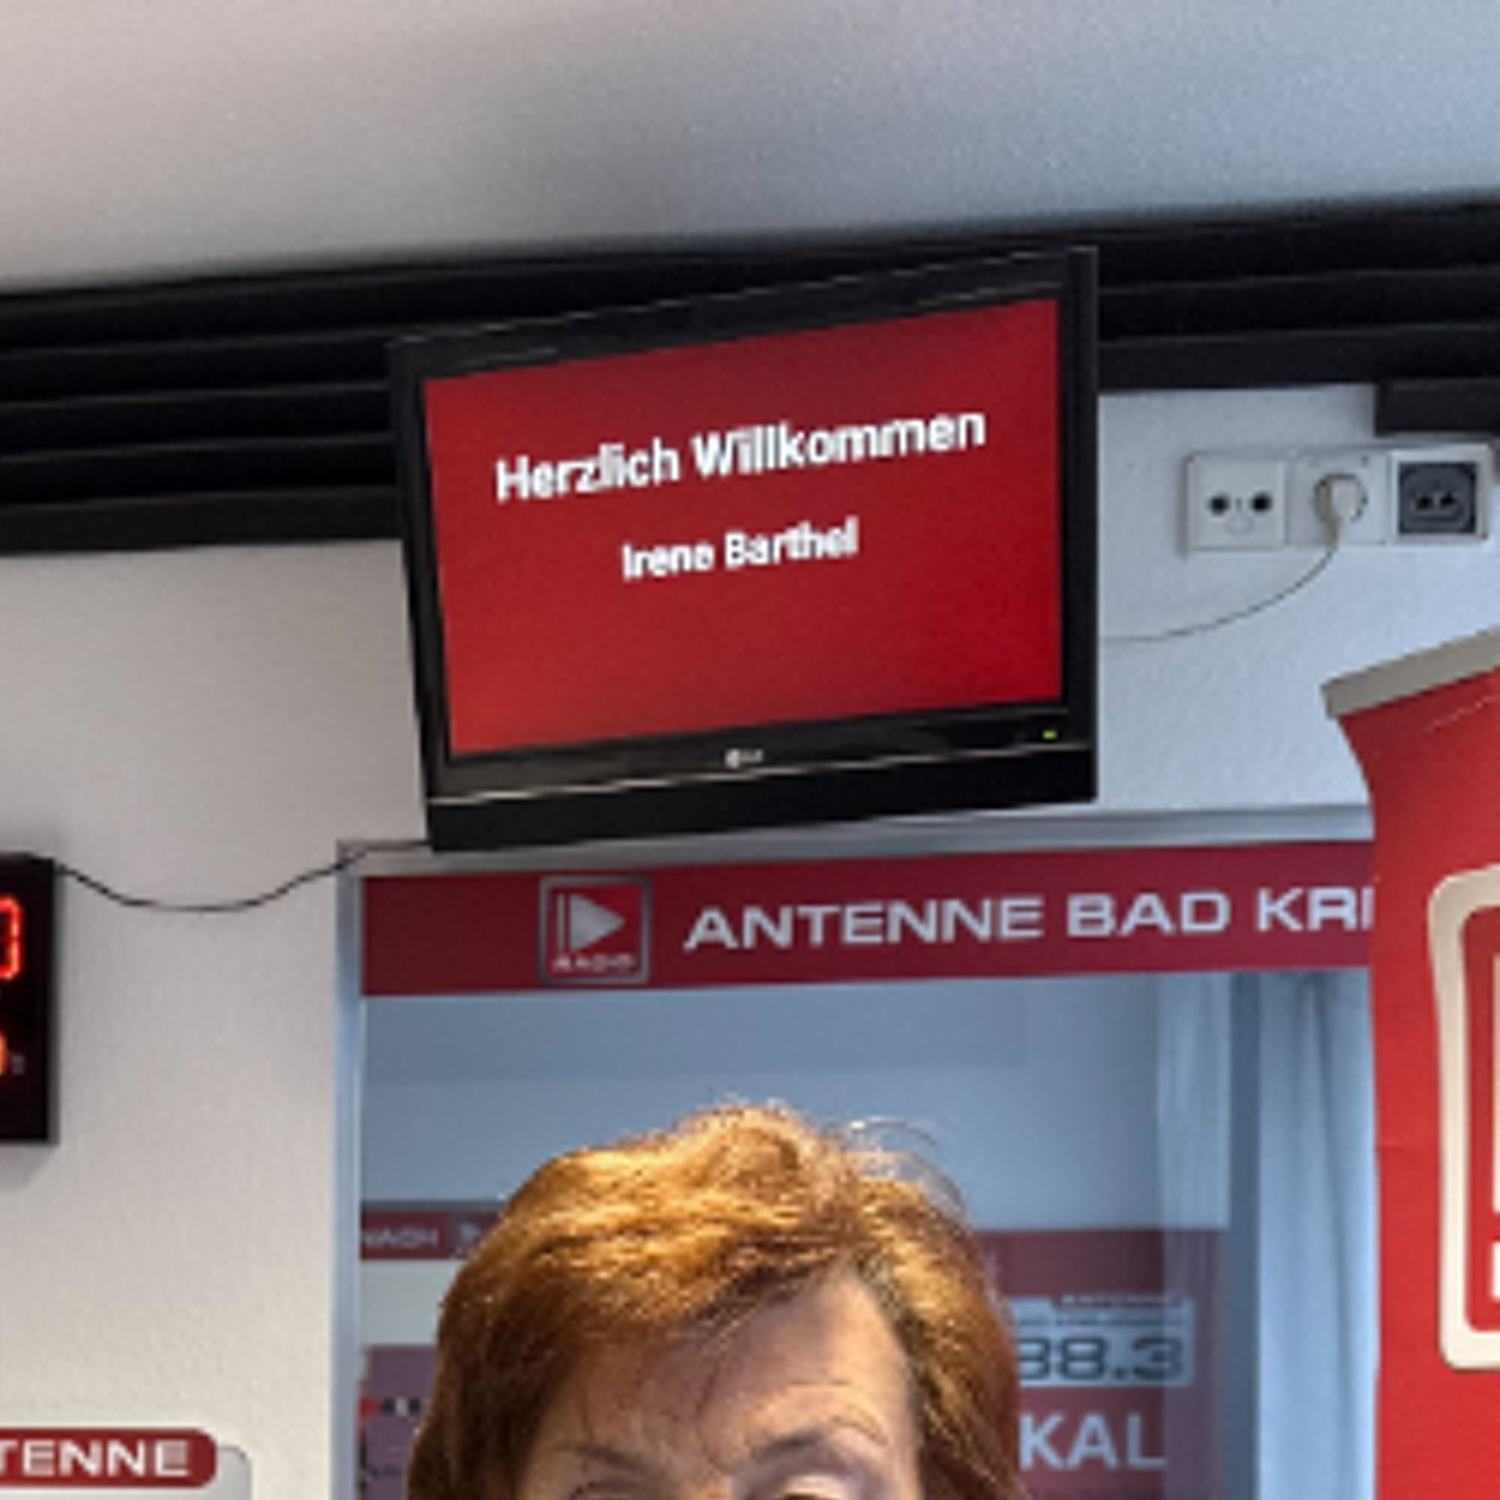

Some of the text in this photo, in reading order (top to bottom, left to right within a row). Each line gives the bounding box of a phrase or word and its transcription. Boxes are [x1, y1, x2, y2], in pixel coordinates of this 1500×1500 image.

[495, 412, 986, 503] Herzlich Willkommen
[621, 515, 862, 582] Irene Barthel
[683, 886, 1376, 950] ANTENNE BAD KR
